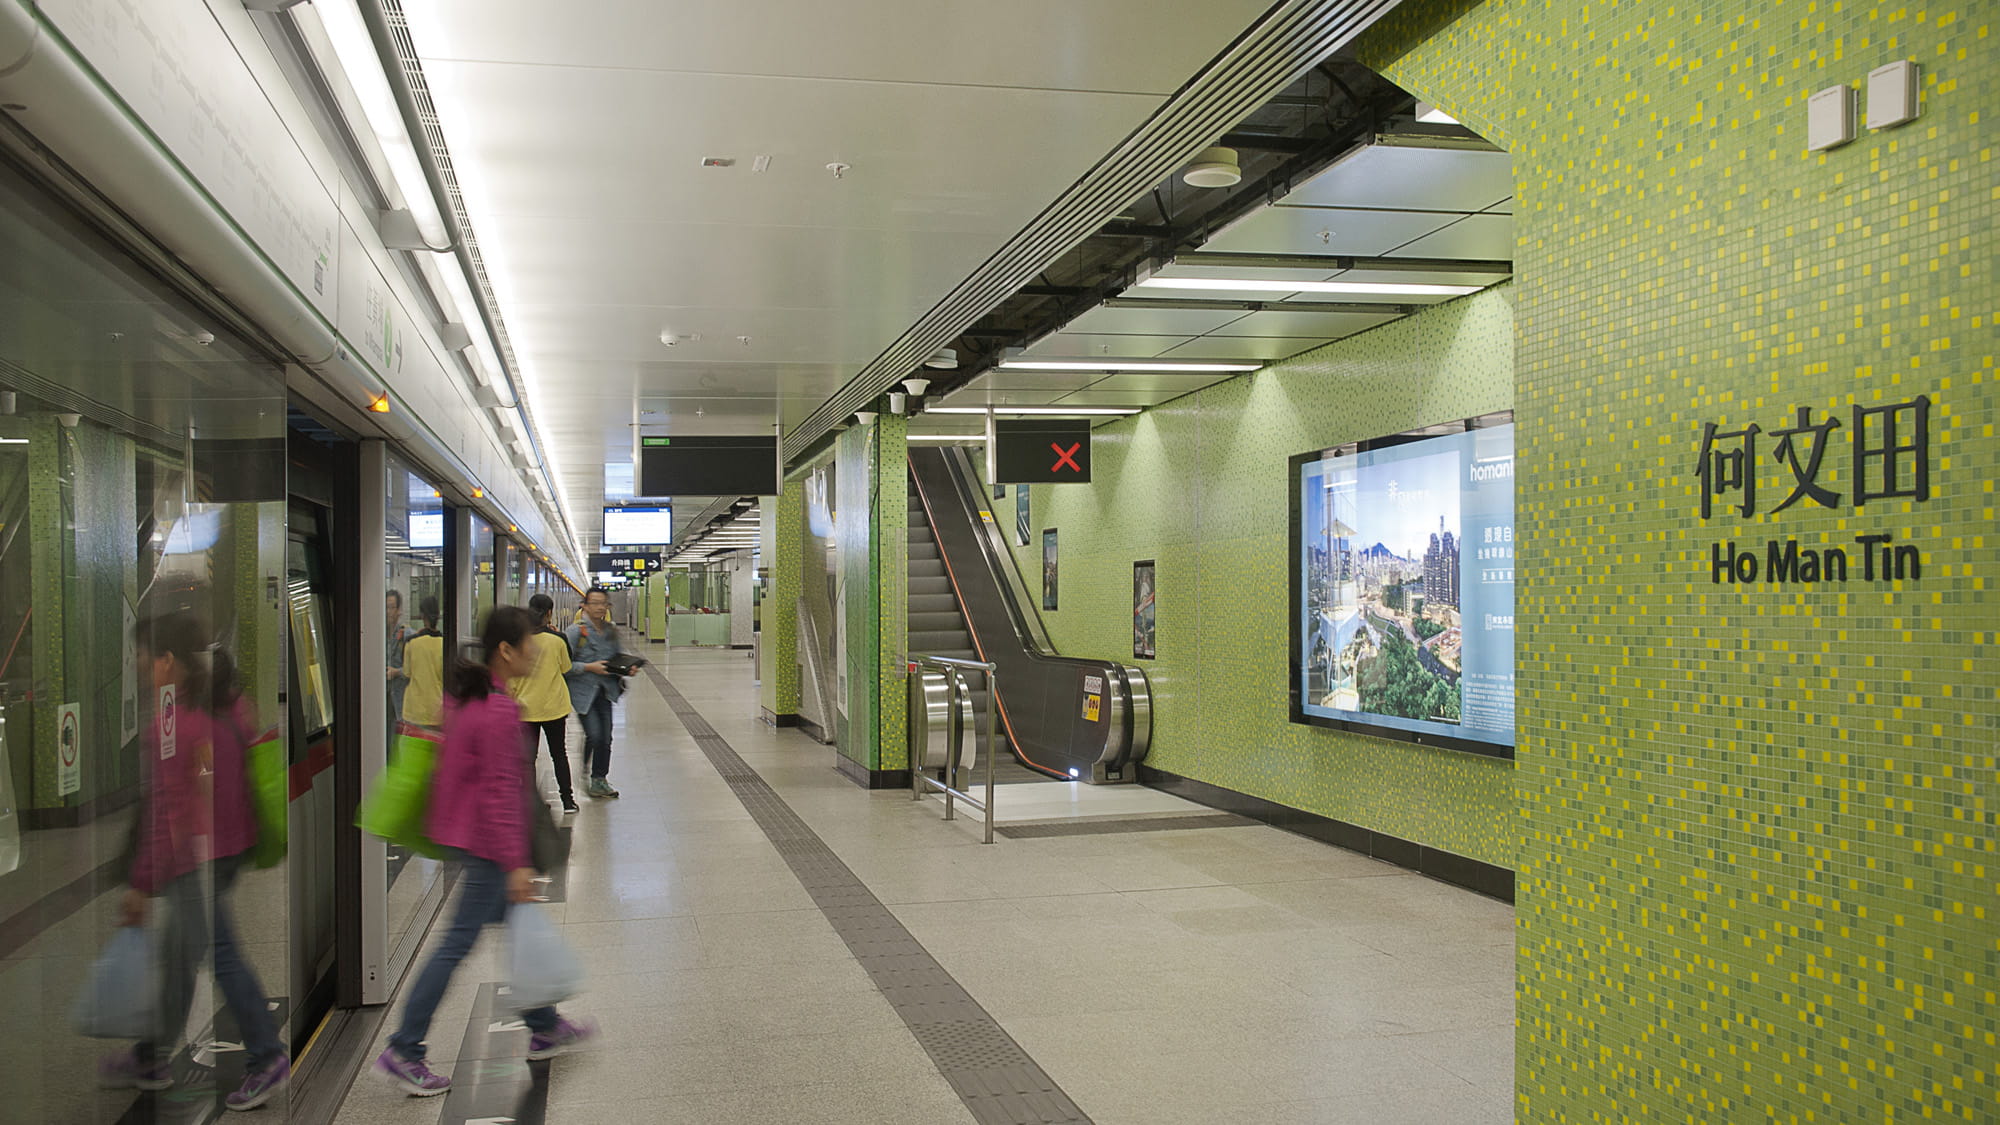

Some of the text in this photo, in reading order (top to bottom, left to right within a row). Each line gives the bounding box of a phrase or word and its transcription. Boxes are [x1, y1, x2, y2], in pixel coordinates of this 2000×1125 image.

[1694, 394, 1931, 520] 何文田
[1711, 533, 1921, 584] Ho Man Tin
